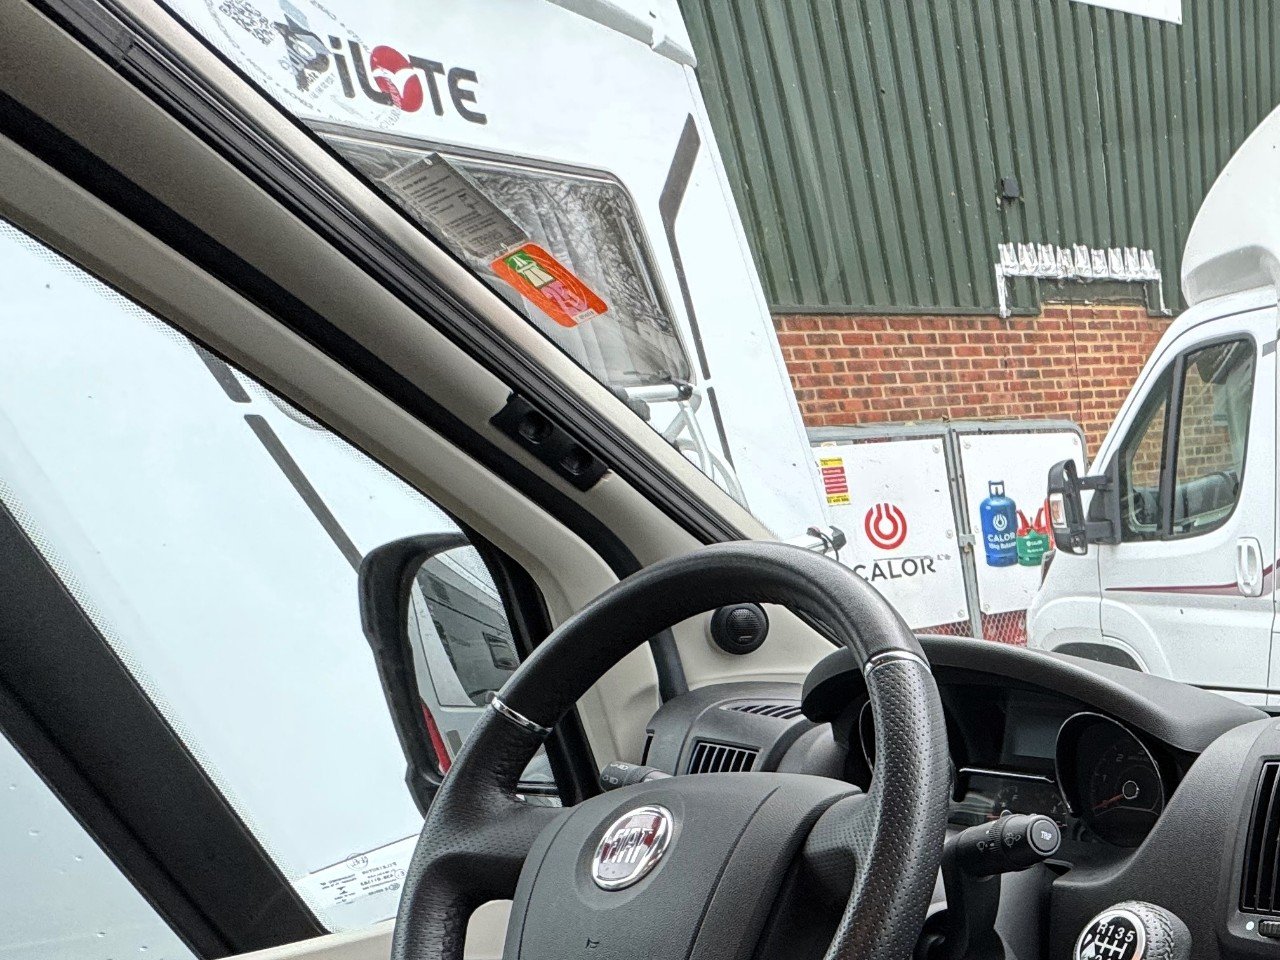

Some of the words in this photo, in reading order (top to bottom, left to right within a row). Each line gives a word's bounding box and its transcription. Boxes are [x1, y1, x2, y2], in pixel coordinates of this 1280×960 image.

[987, 532, 1016, 542] CALOR
[853, 558, 937, 582] CALOR
[603, 827, 654, 863] FIAT
